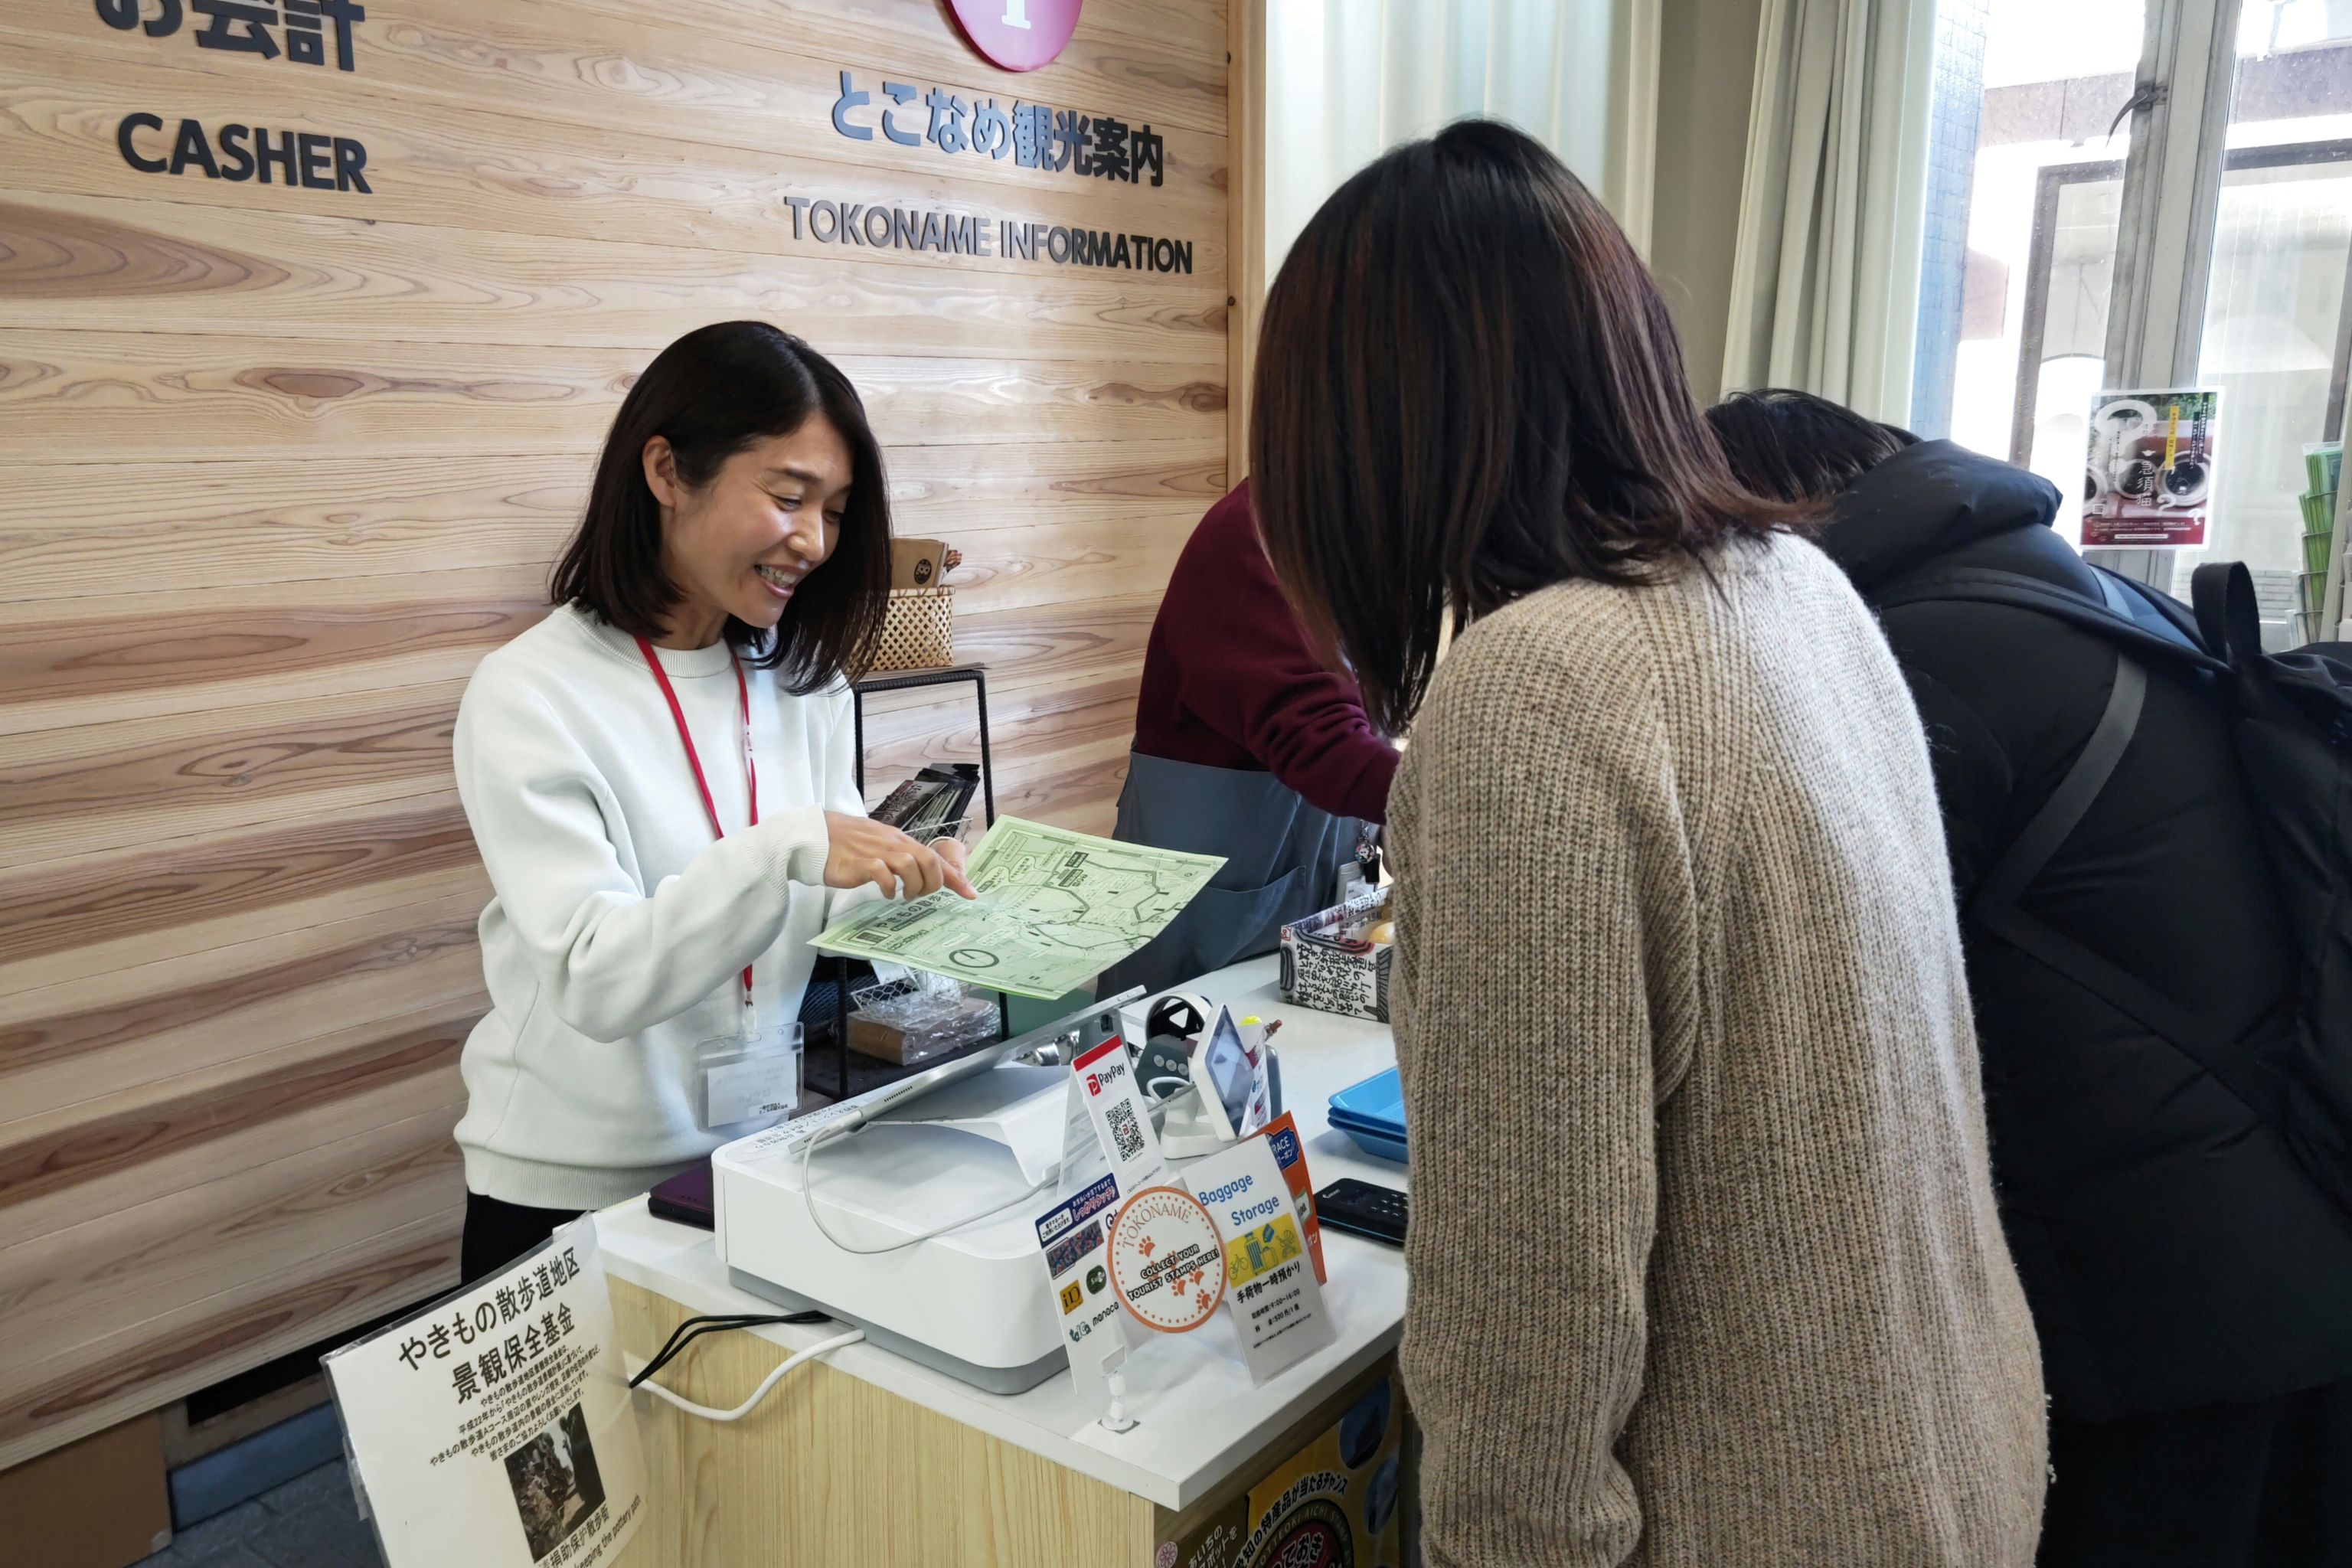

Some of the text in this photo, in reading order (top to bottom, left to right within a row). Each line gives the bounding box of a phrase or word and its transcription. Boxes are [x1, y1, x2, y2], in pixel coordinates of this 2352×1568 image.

[832, 70, 1164, 187] とこなめ観光案内
[117, 113, 372, 194] CASHER
[784, 196, 1192, 274] TOKONAME INFORMATION
[1098, 1063, 1125, 1086] PayPay
[1198, 1174, 1253, 1206] Baggage
[1231, 1197, 1279, 1226] Storage
[1122, 1203, 1191, 1249] TOKONAME
[1127, 1248, 1220, 1302] TOURIST STAMPS HERE!
[1140, 1243, 1200, 1280] COLLECT YOUR
[1236, 1260, 1300, 1304] 手荷物一時預かり
[399, 1246, 580, 1370] やきもの散歩道地区
[1063, 1286, 1080, 1308] iD
[452, 1302, 574, 1404] 景観保全基金
[602, 1532, 612, 1548] the
[612, 1508, 631, 1539] pottery
